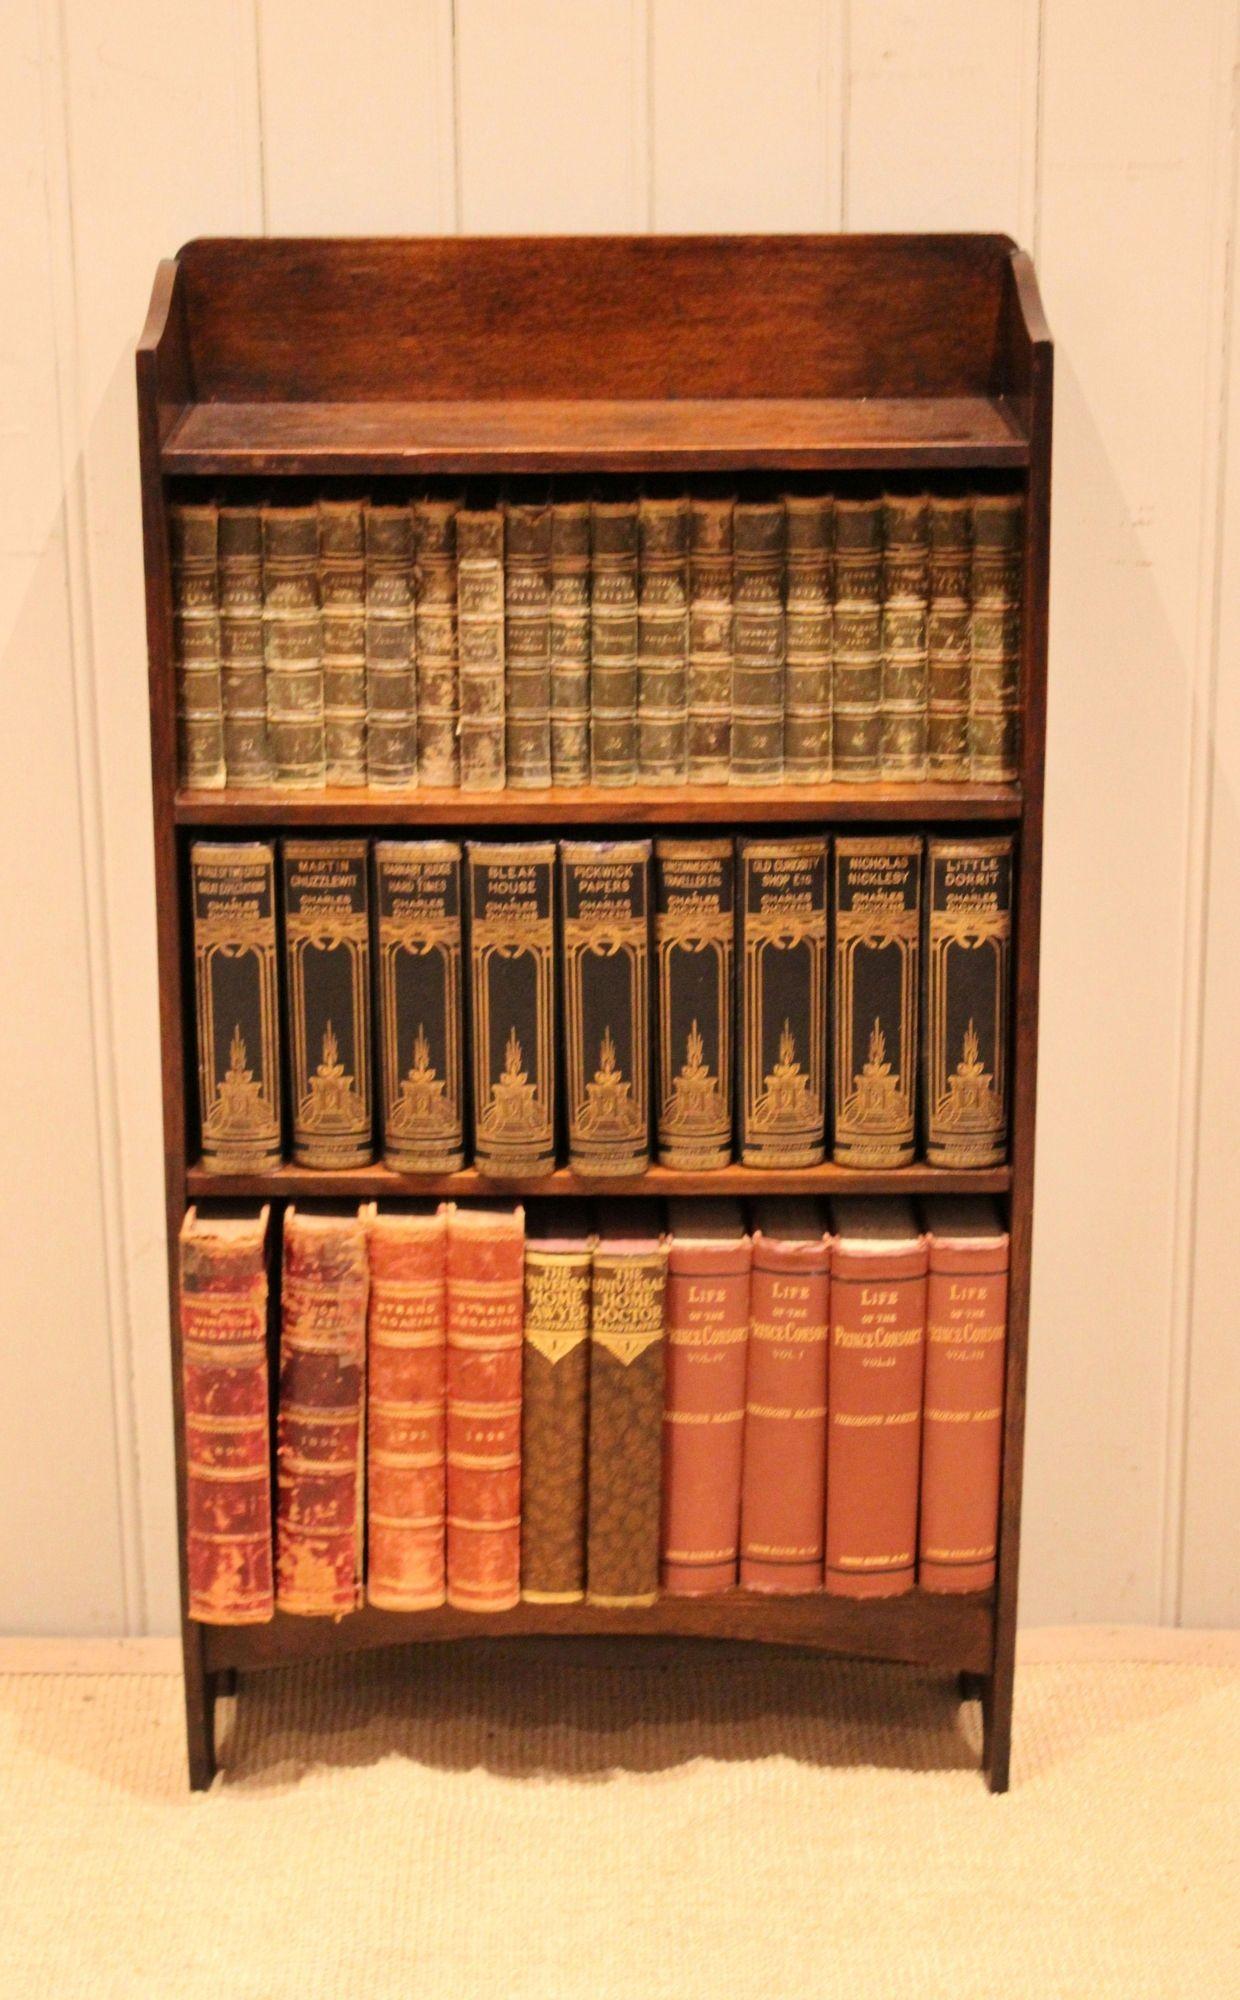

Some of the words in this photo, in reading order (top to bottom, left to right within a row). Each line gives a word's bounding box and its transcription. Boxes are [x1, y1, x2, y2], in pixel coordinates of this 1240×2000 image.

[298, 860, 349, 872] MARTIN
[850, 857, 908, 869] NICHOLAS
[946, 859, 999, 873] LITTLE
[488, 866, 537, 879] BLEAK
[574, 865, 633, 878] PICKWICK
[290, 874, 357, 888] CHUZZLEWIT
[848, 872, 909, 885] NICKLEBY
[945, 873, 999, 887] DORRIT
[488, 880, 536, 894] HOUSE
[579, 880, 630, 893] PAPERS
[377, 1302, 434, 1315] STRAND
[457, 1303, 516, 1315] STRAND
[593, 1306, 662, 1323] DOCTOR
